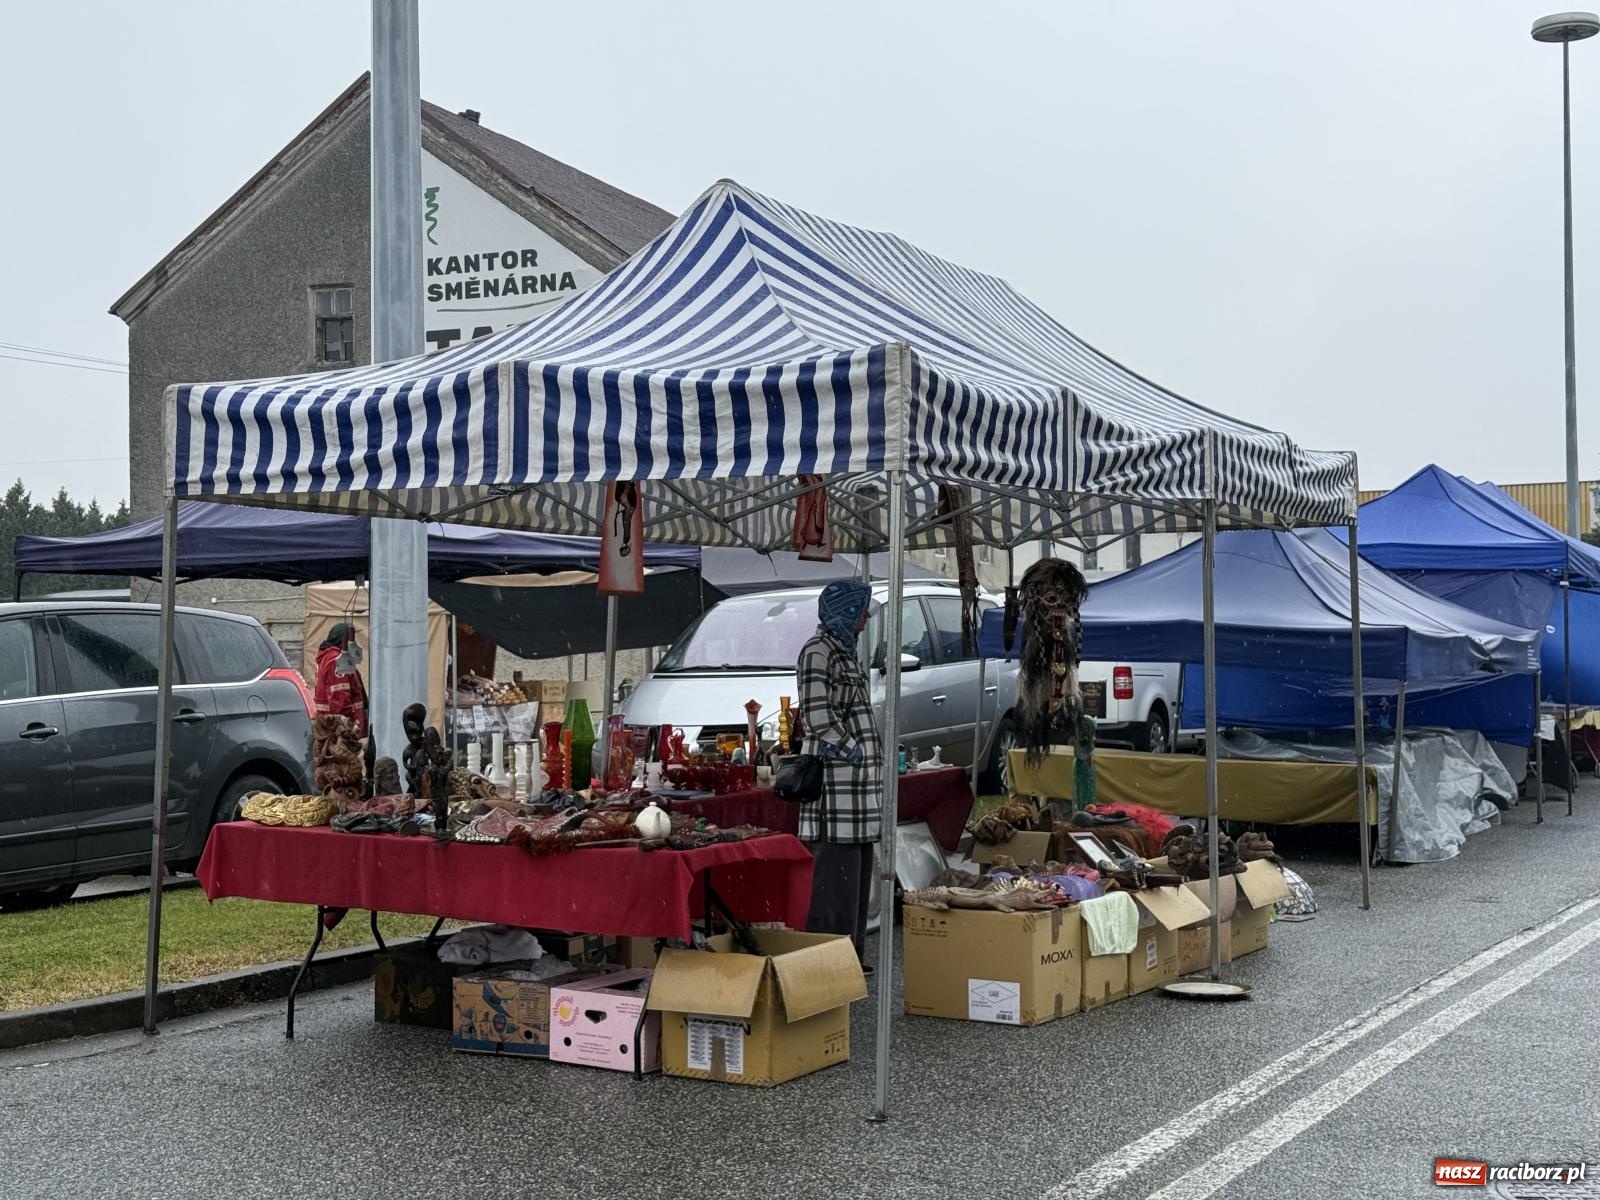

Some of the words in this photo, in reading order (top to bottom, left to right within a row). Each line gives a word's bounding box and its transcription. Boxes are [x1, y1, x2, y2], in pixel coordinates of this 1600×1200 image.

[427, 249, 538, 276] KANTOR
[427, 271, 577, 302] SMĚNÁRNA
[1041, 949, 1073, 966] MOXA
